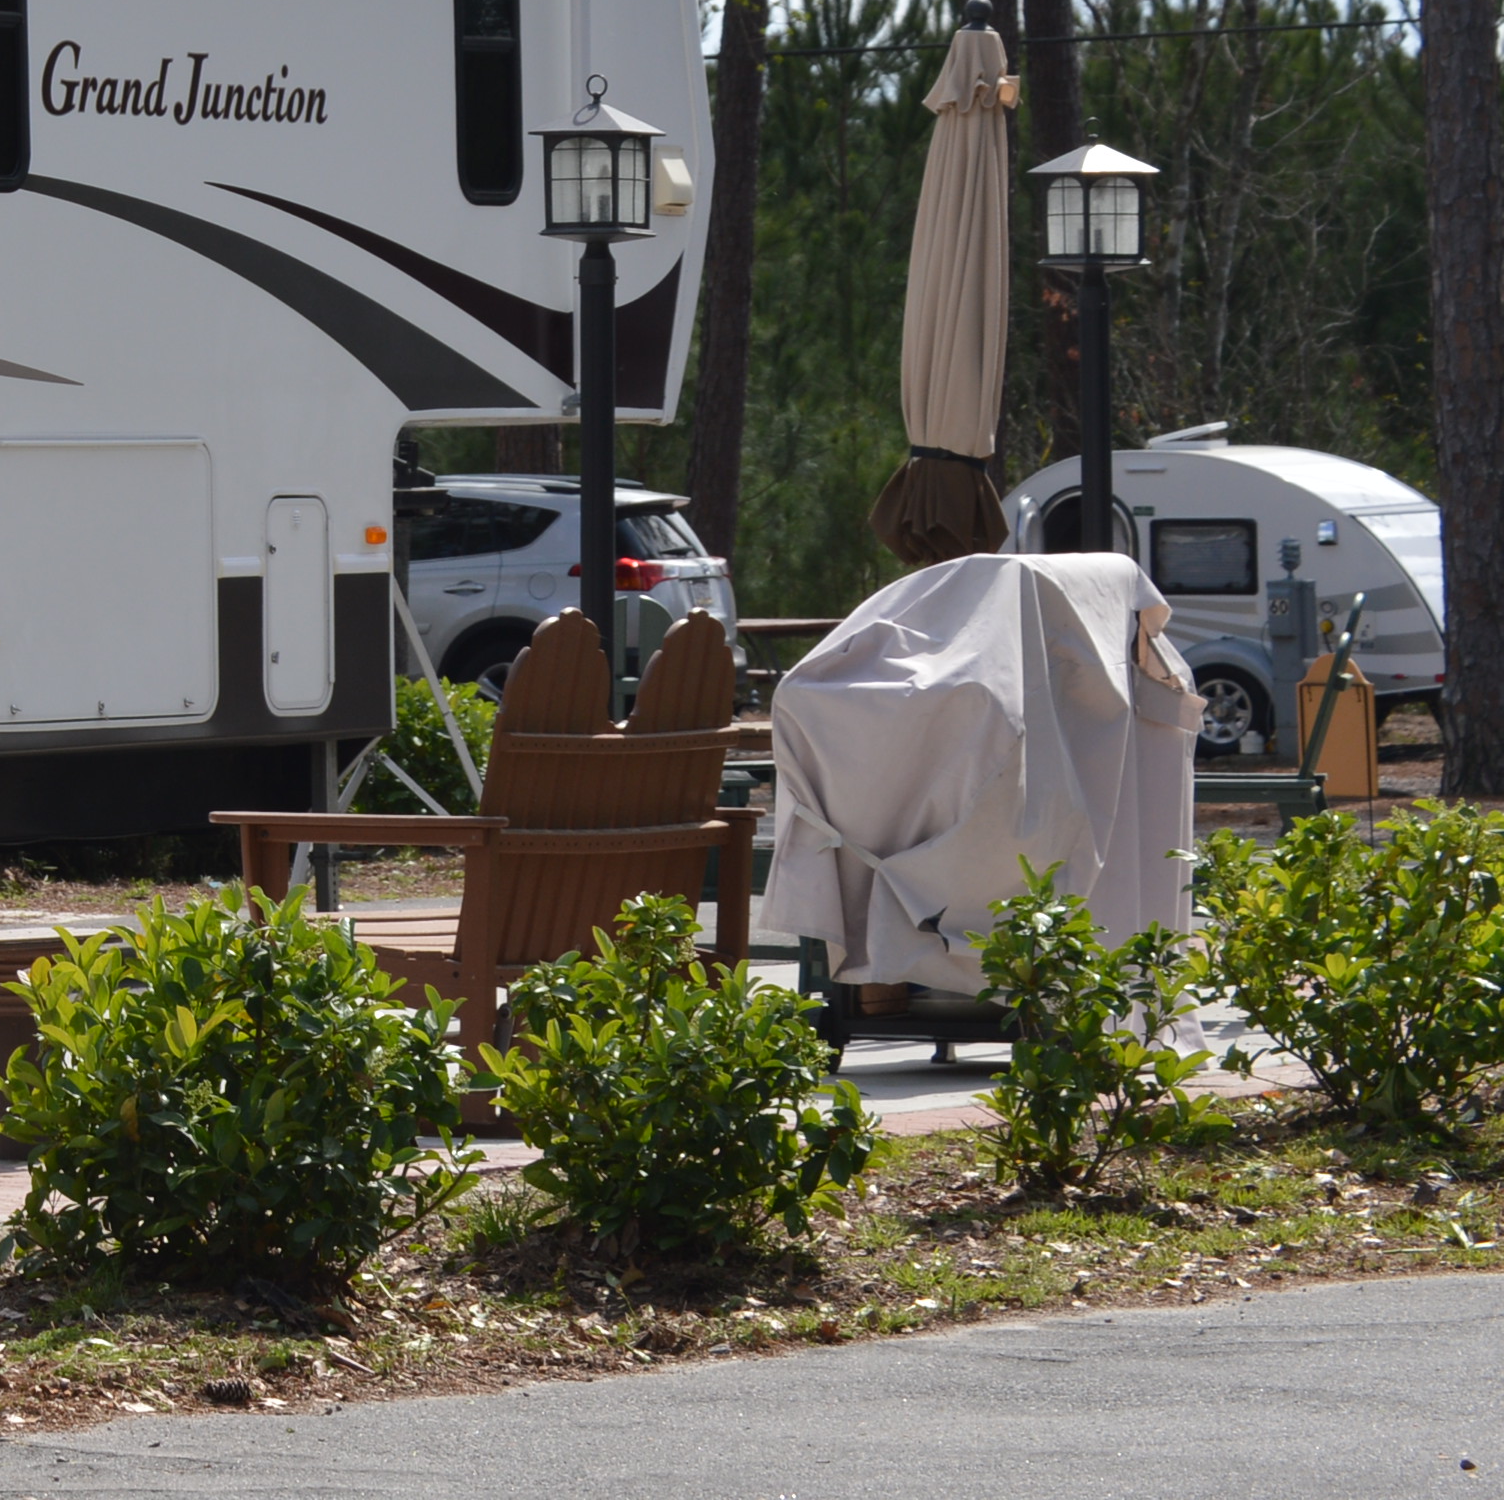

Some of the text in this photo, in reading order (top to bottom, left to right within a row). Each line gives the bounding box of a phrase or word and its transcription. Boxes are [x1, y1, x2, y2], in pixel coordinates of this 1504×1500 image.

[41, 40, 328, 126] Grand Junction
[1269, 599, 1289, 615] 60
